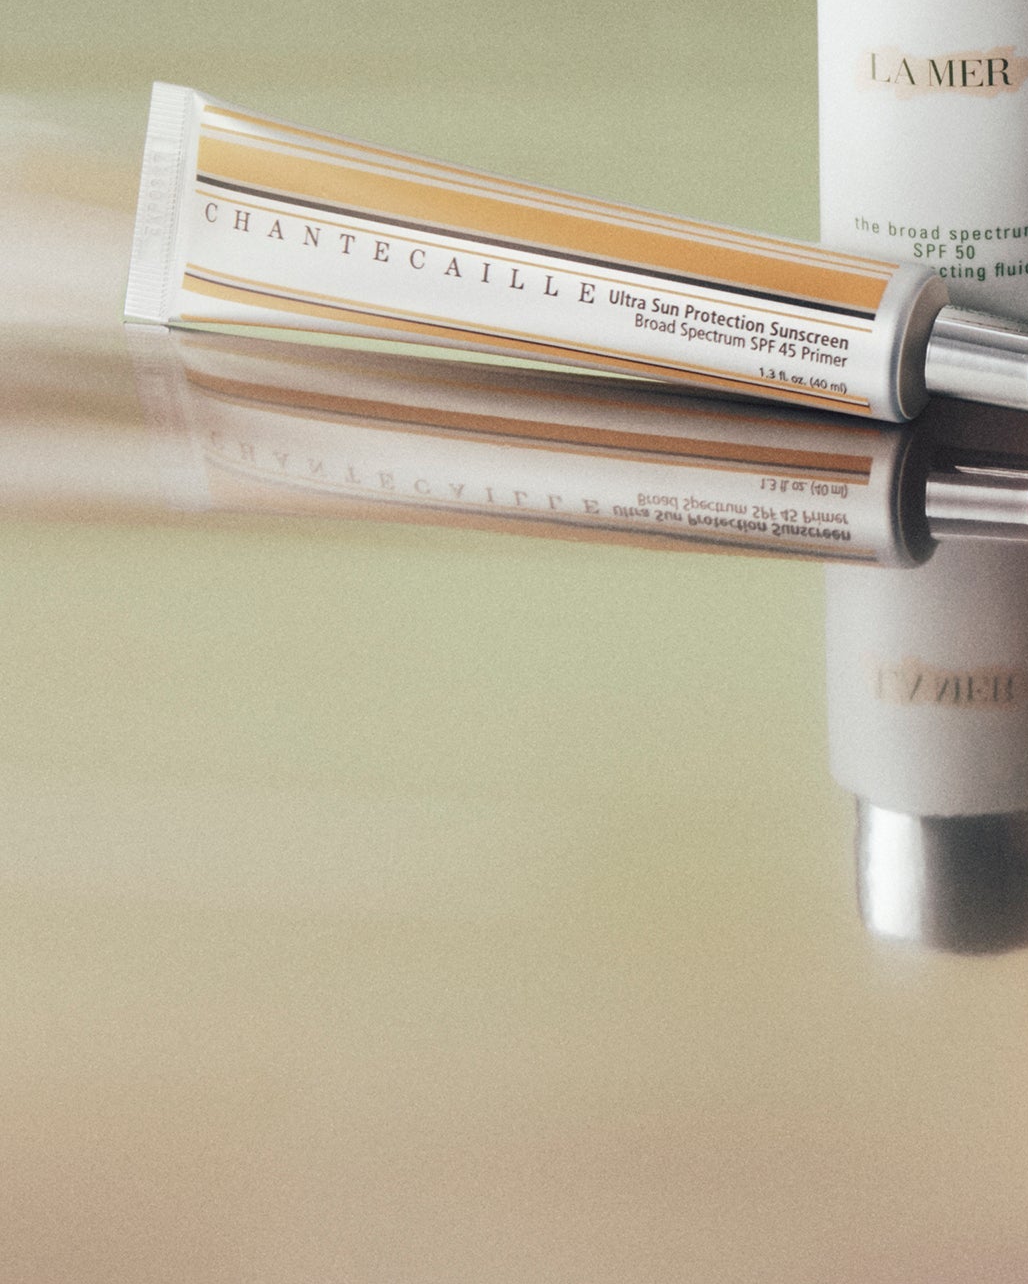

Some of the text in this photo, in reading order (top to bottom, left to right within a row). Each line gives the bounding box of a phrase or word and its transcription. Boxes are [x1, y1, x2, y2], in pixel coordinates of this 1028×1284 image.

[870, 52, 1014, 88] LA MER
[854, 216, 880, 234] the
[888, 221, 940, 240] broad
[204, 201, 596, 305] CHANTECAILLE
[913, 242, 976, 260] SPF 50
[931, 263, 986, 282] cting
[608, 288, 849, 351] Ultra Sun Protection Sunscreen
[634, 313, 848, 368] Broad Spectrum SPF 45 Primer
[758, 367, 777, 380] 1.3
[791, 375, 807, 386] oz.
[809, 375, 828, 392] (40
[830, 380, 848, 395] ml)
